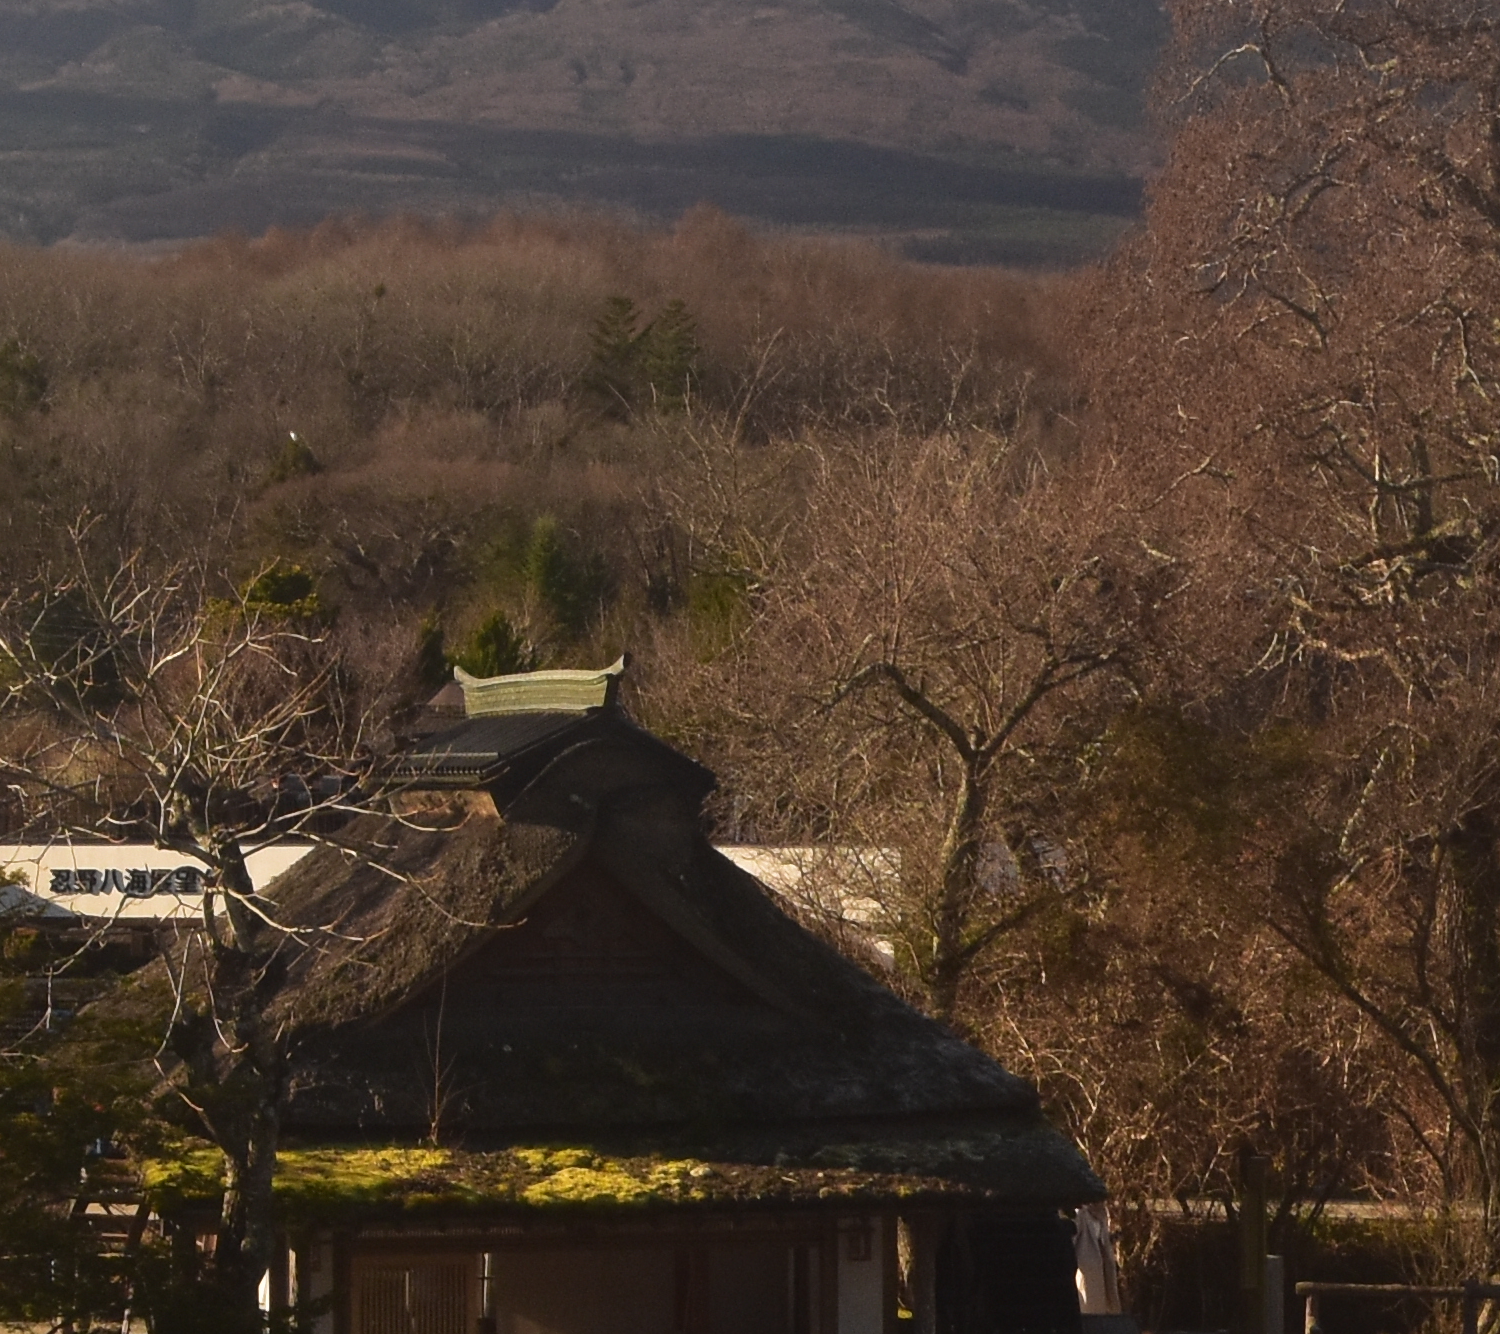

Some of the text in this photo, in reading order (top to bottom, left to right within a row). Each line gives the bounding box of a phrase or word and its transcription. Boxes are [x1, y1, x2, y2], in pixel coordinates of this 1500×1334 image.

[49, 867, 217, 895] 忍野八海展望
